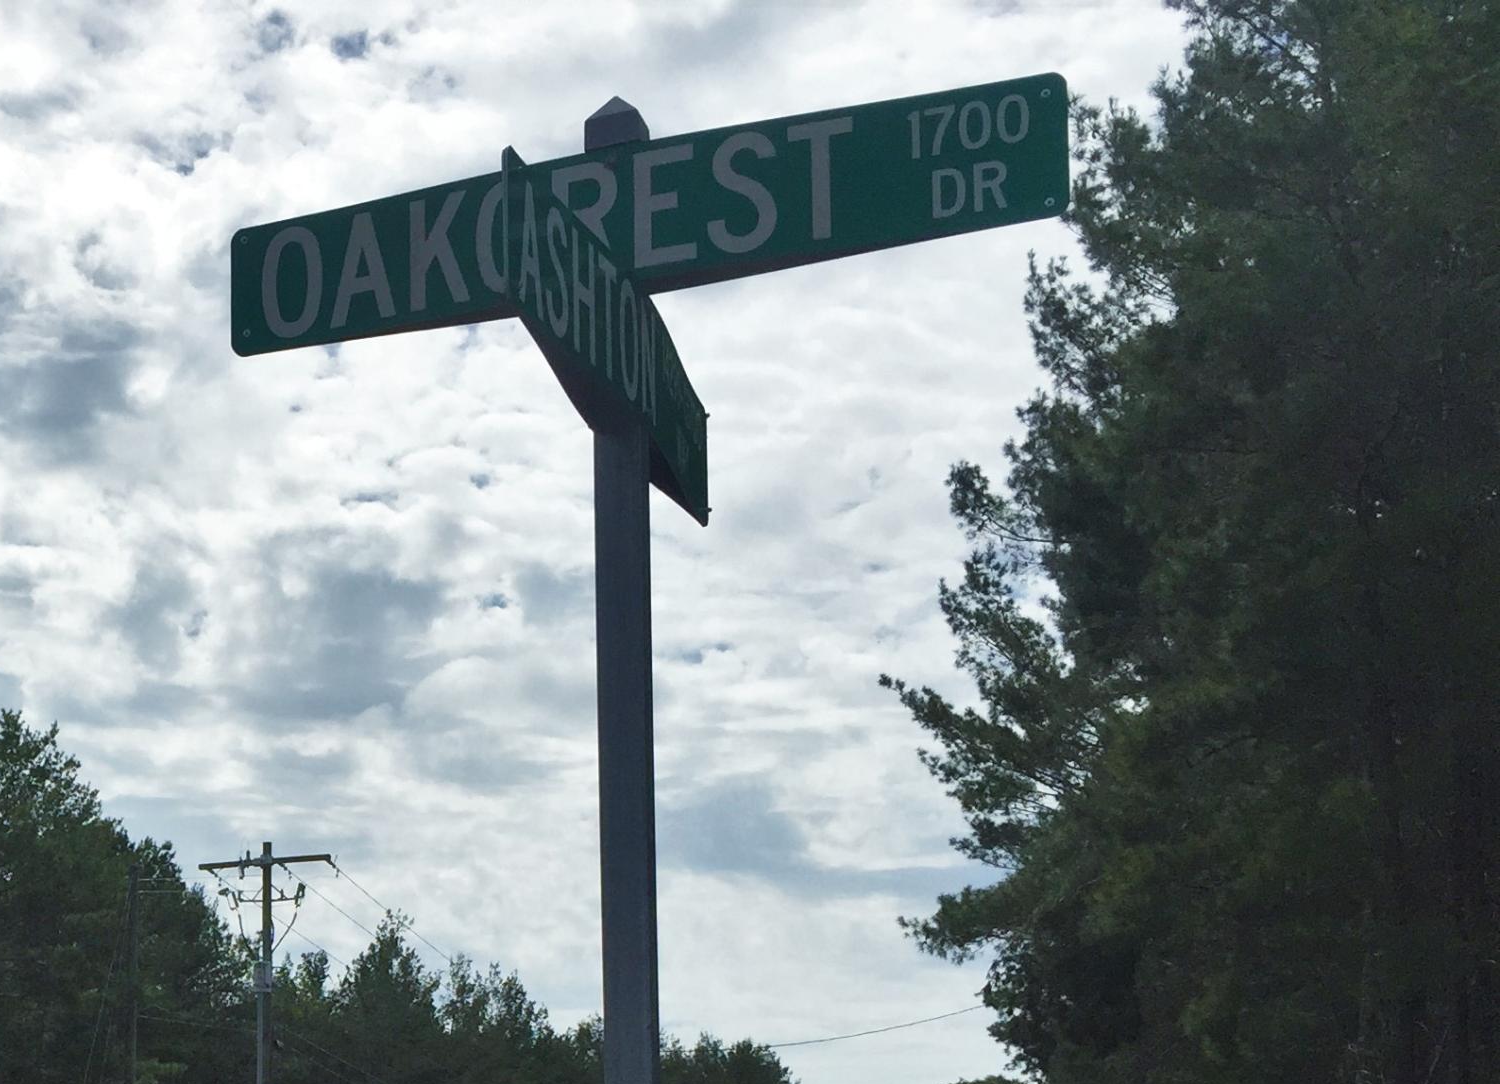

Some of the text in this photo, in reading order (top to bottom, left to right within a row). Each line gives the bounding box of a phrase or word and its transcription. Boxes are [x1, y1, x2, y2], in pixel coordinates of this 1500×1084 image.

[907, 93, 1030, 160] 1700
[931, 160, 1008, 219] DR
[518, 180, 657, 426] ASHTON
